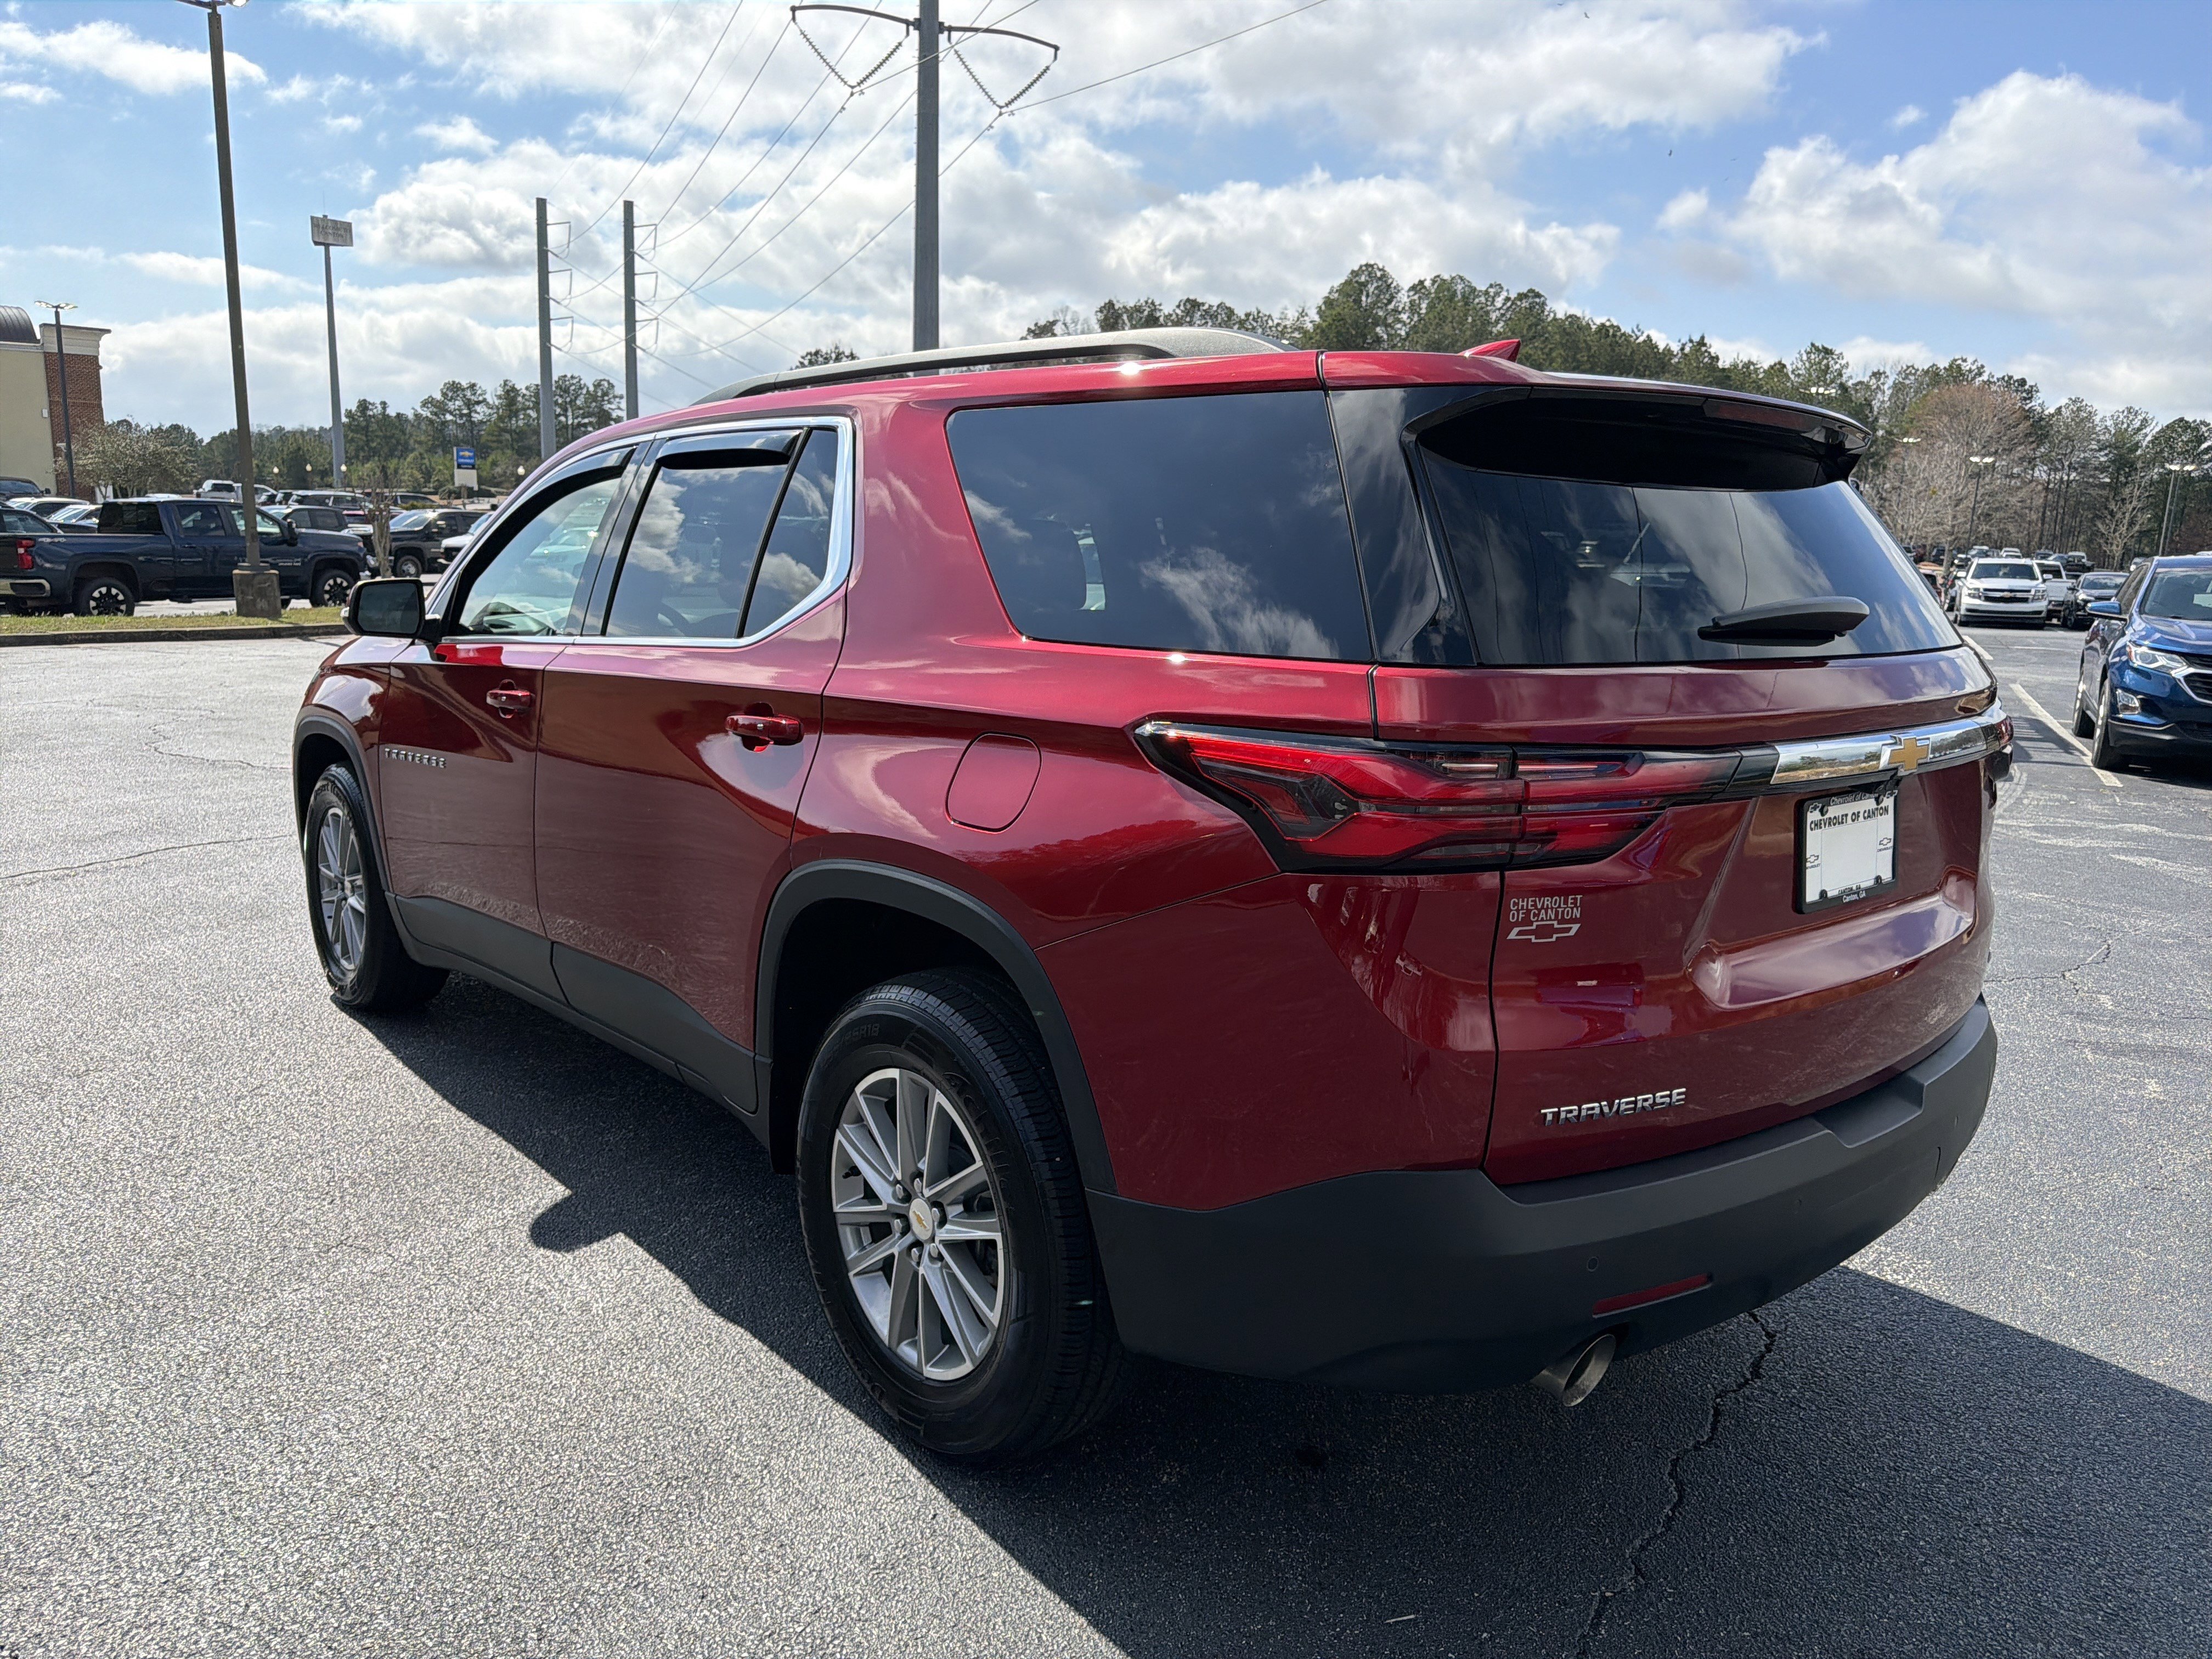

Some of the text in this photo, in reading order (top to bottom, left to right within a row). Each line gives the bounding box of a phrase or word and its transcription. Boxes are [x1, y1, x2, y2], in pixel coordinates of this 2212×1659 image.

[384, 748, 447, 769] TRAVERSE
[1830, 793, 1855, 806] Chevrolet
[1855, 792, 1863, 801] of
[1809, 805, 1889, 832] CHEVROLET OF CANTON
[1859, 890, 1866, 899] GA
[1510, 895, 1583, 910] CHEVROLET
[1509, 907, 1581, 922] OF CANTON
[1541, 1088, 1687, 1127] TRAVERSE
